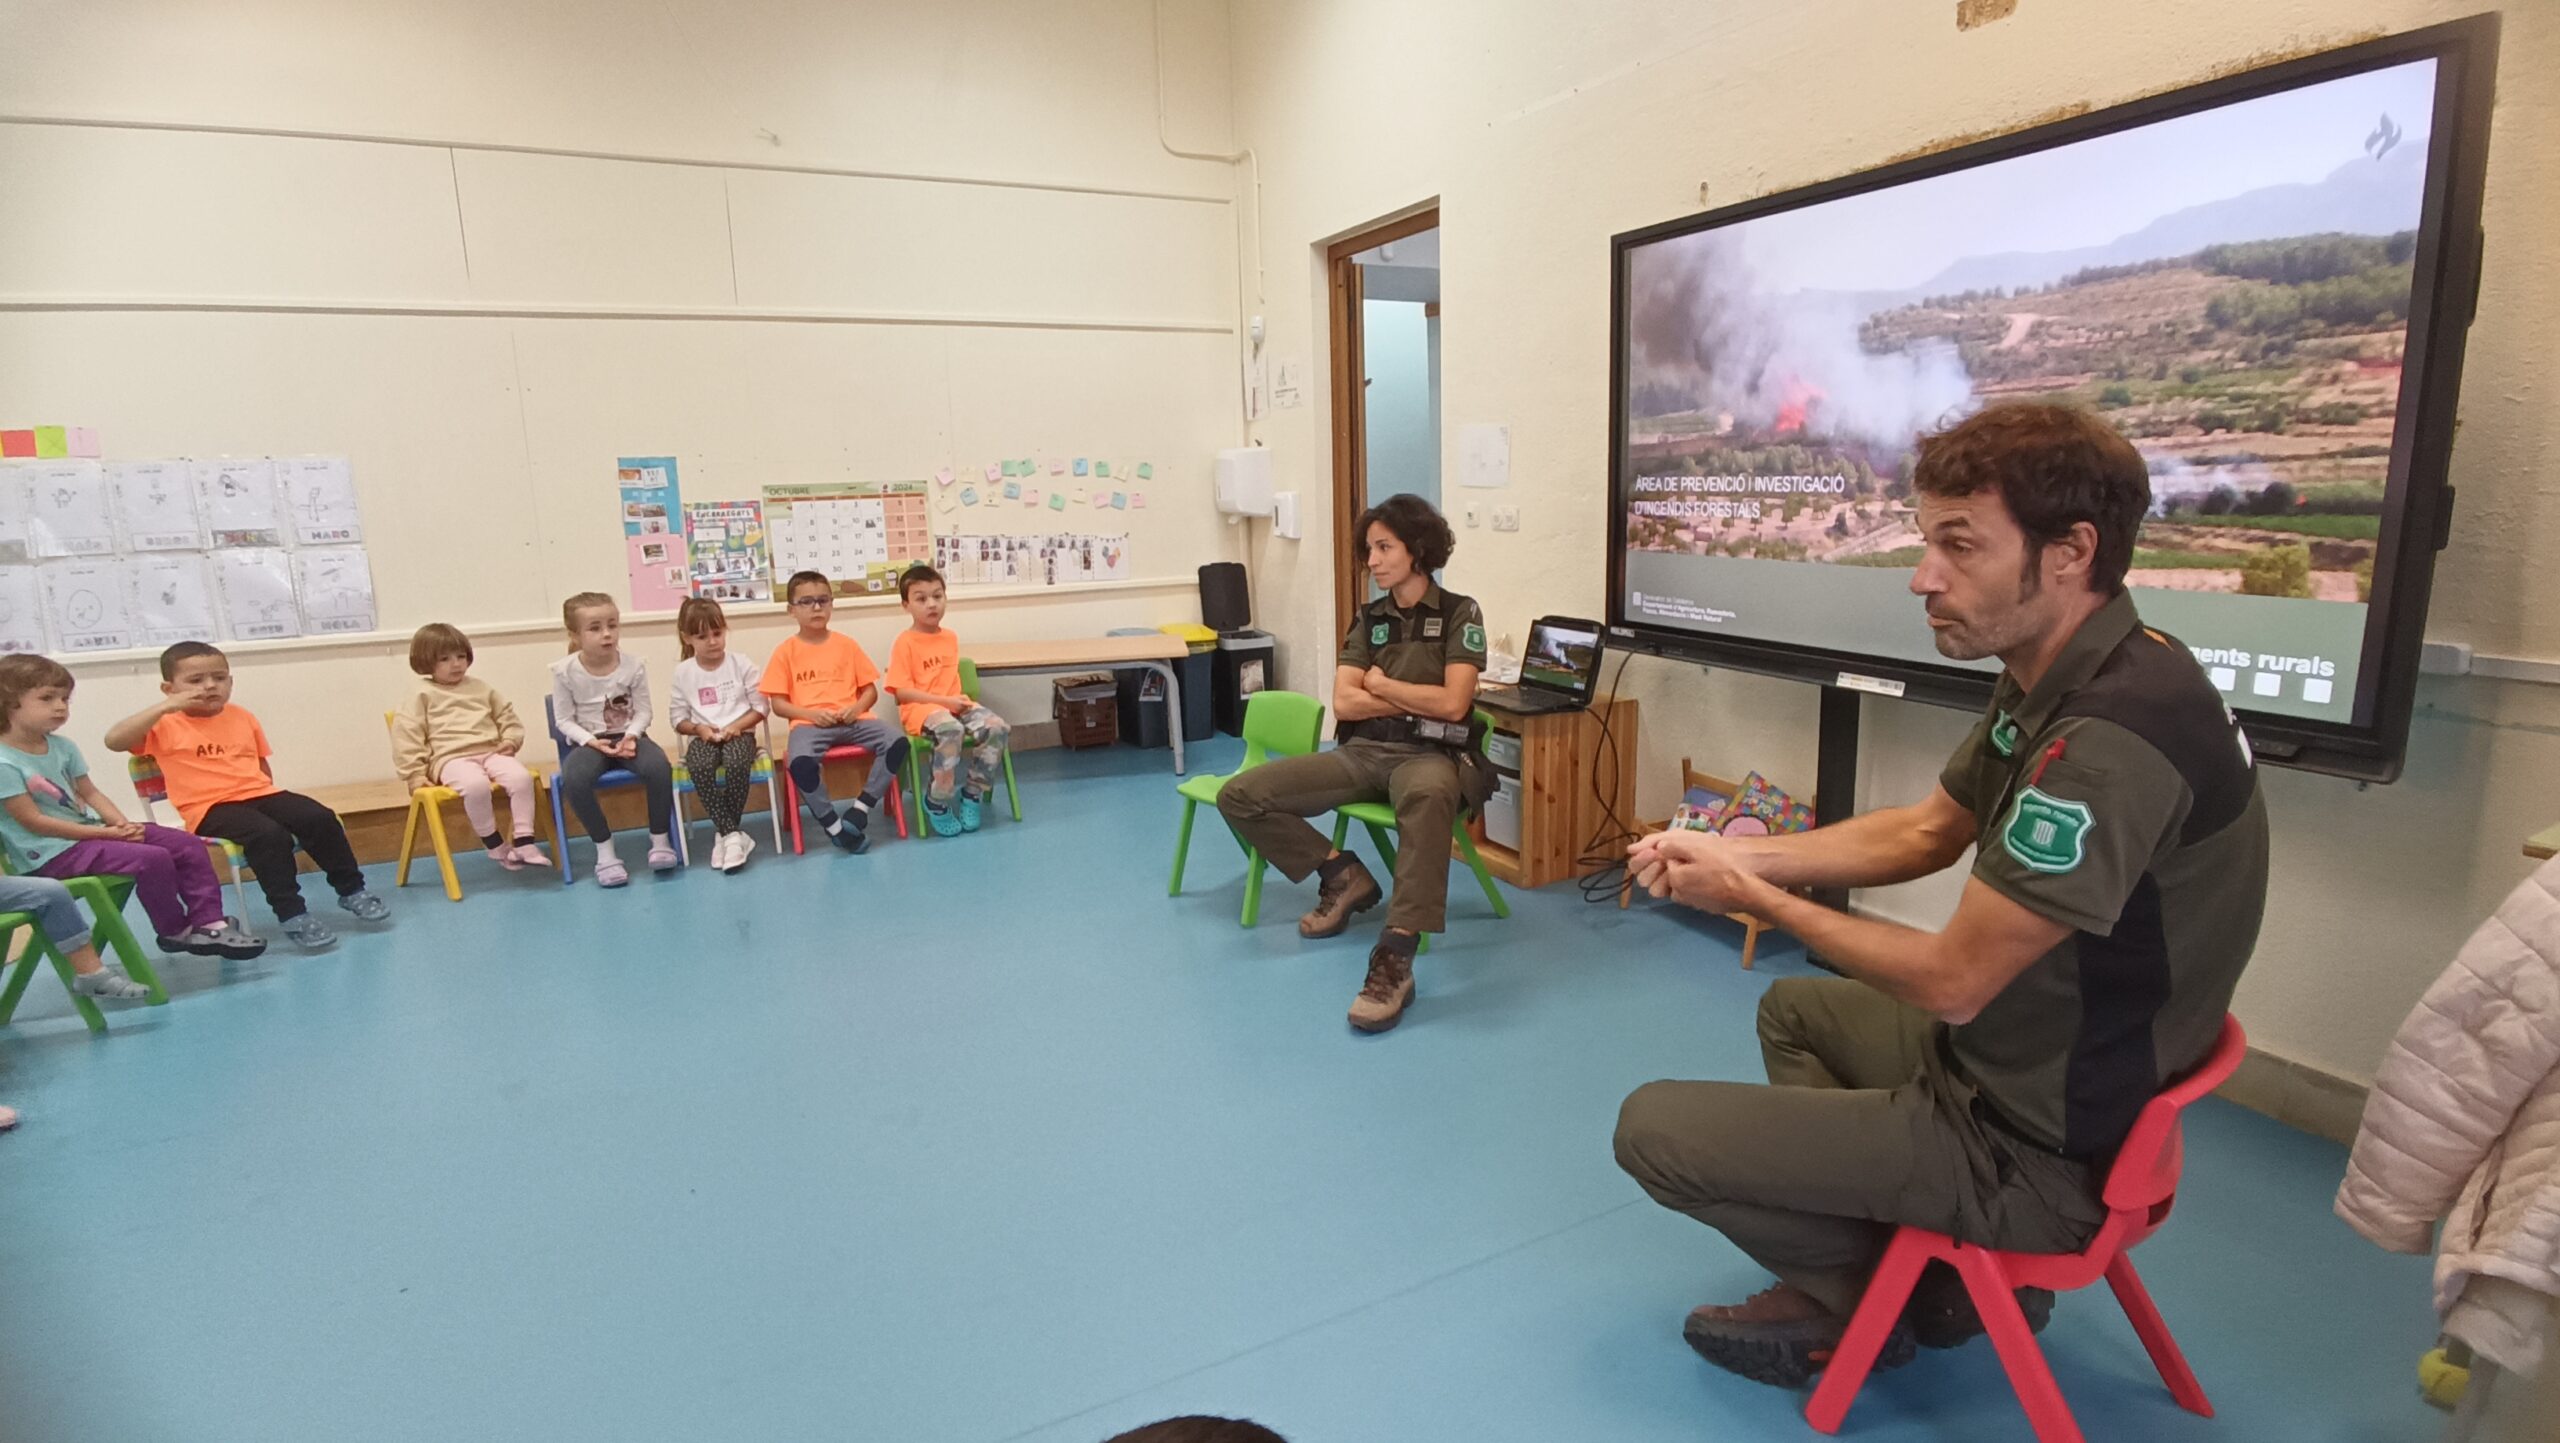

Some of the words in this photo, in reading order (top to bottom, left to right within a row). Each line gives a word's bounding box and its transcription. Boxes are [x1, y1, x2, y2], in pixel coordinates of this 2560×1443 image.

[769, 487, 810, 495] OCTUBRE
[1635, 475, 1662, 492] ÀREA
[1664, 477, 1677, 491] DE
[1681, 474, 1745, 493] PREVENCIÓ
[1755, 473, 1845, 493] INVESTIGACIÓ
[1694, 502, 1760, 519] FORESTALS
[2258, 654, 2336, 677] rurals
